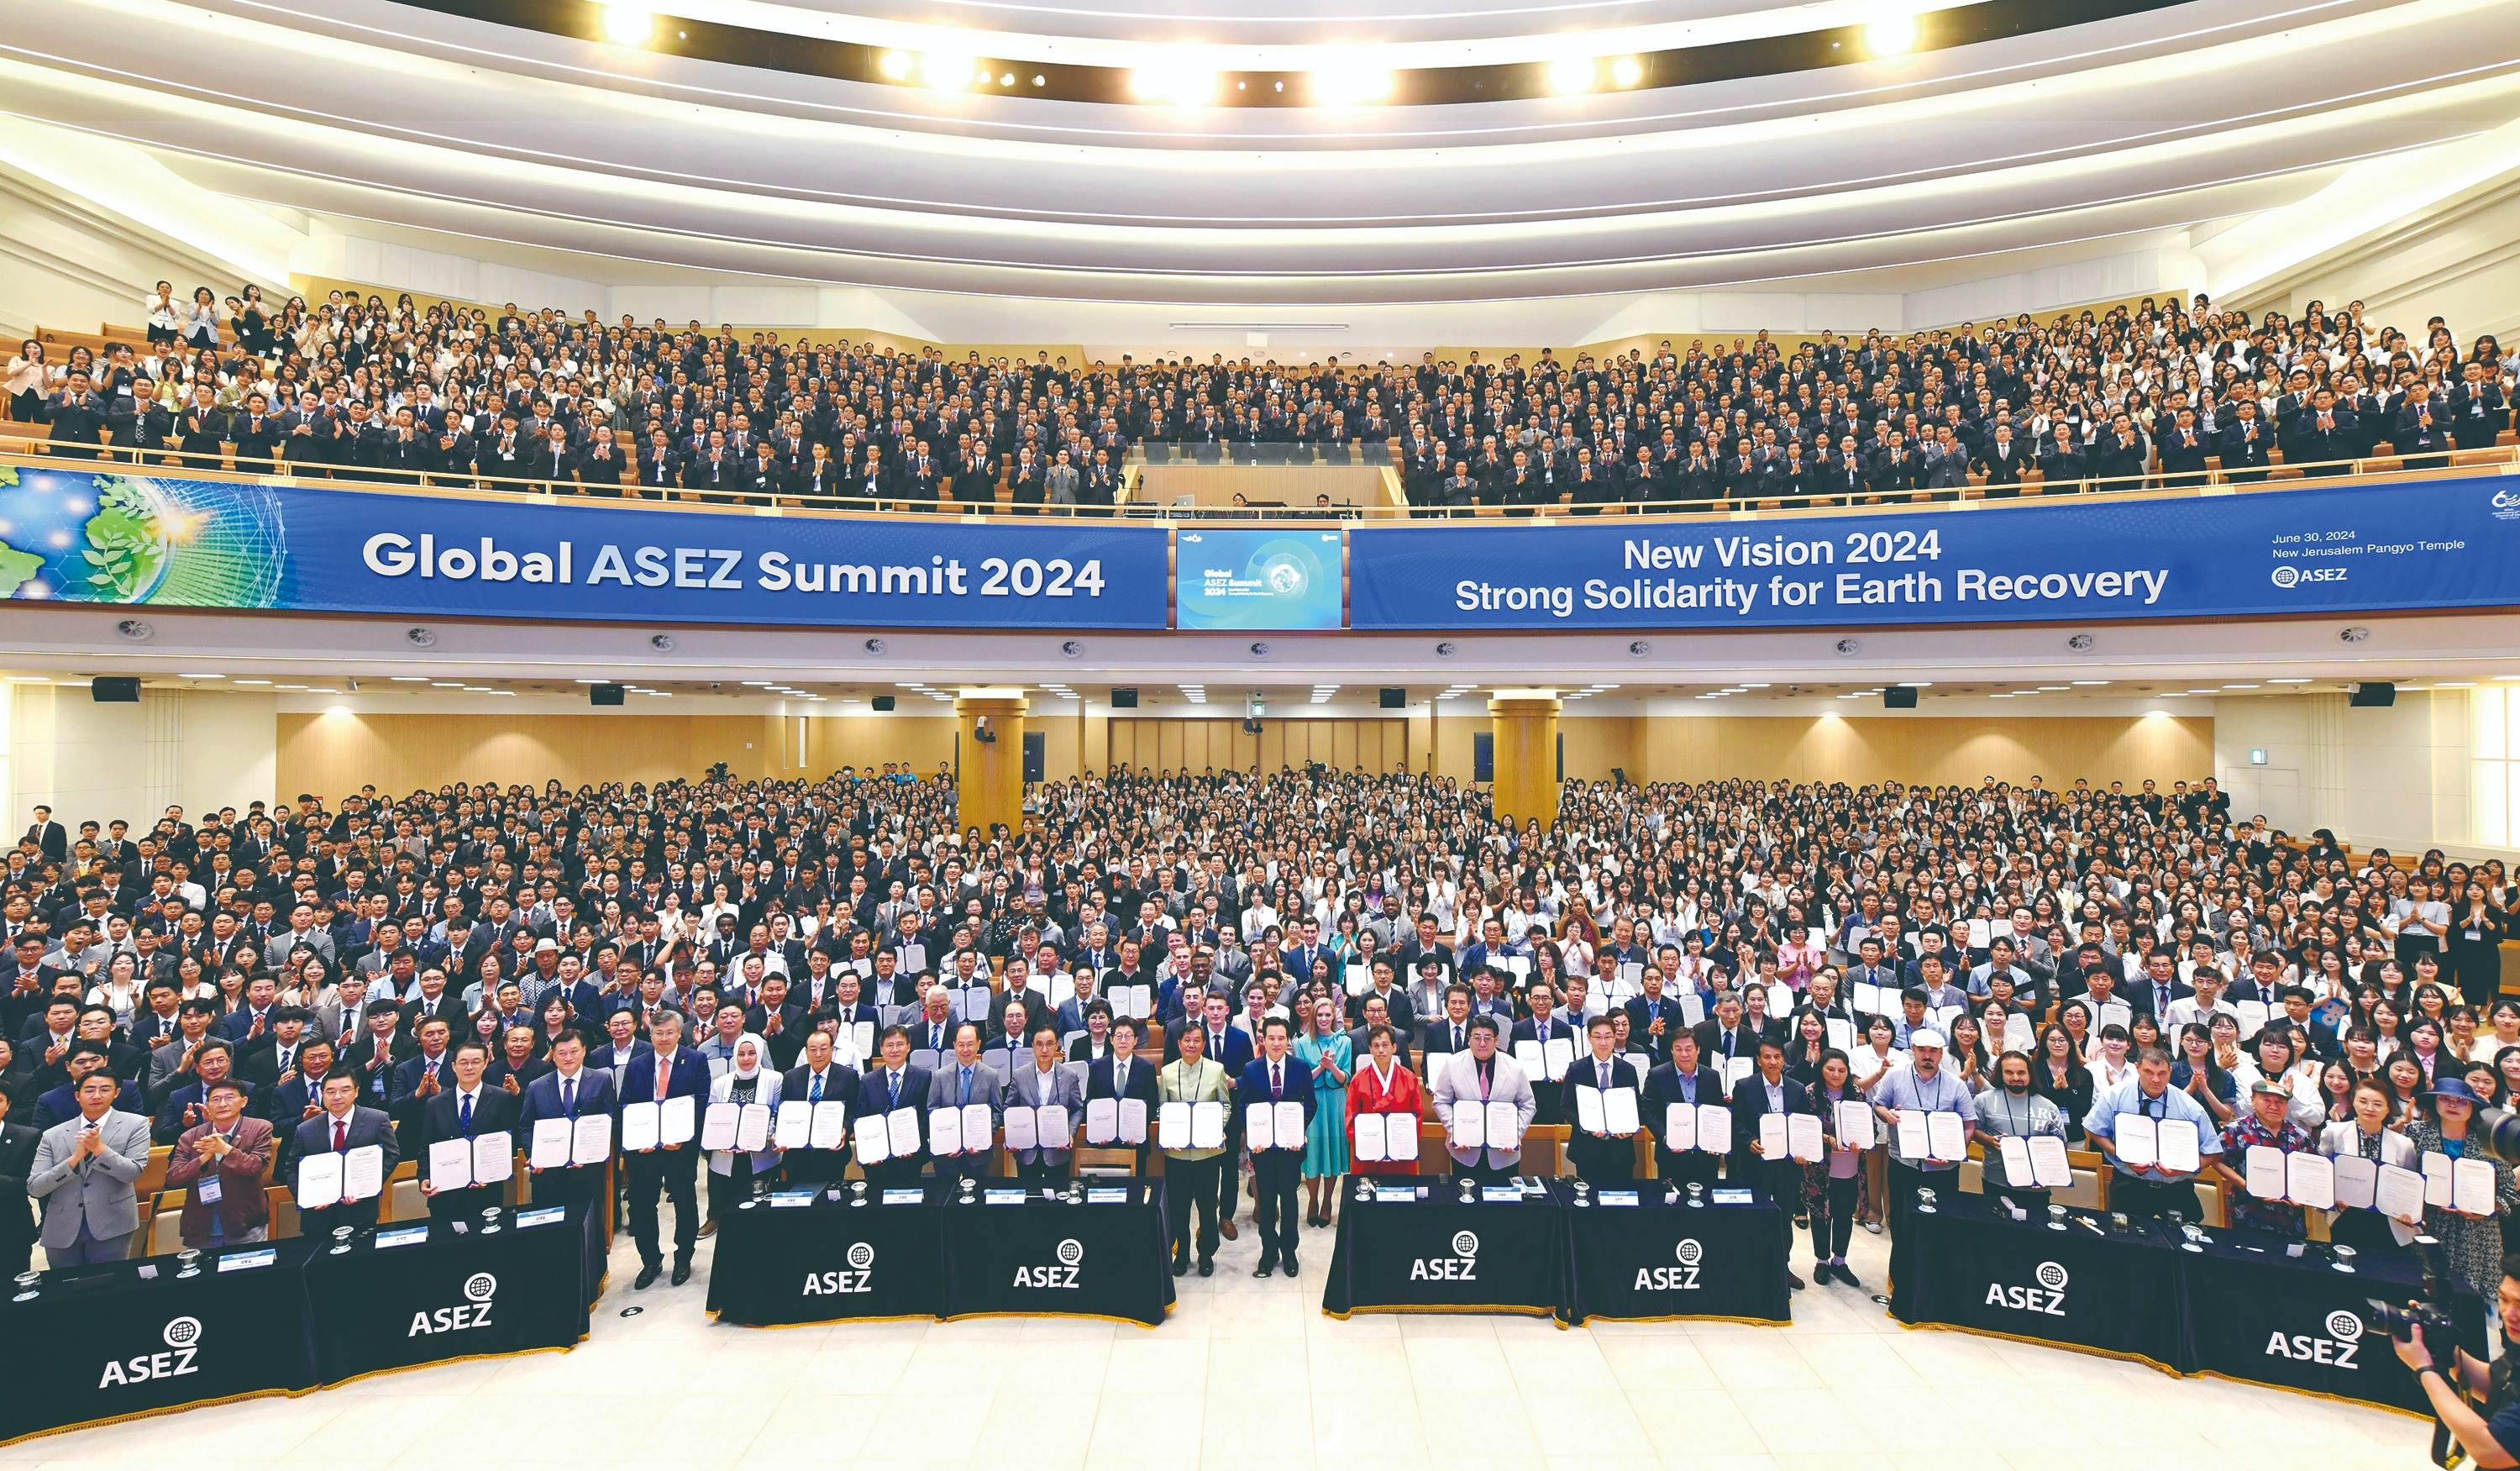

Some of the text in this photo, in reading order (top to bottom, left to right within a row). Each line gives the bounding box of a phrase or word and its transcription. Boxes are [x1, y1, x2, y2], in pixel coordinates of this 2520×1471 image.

[2271, 530, 2356, 544] June 30, 2024
[1625, 528, 1942, 570] New Vision 2024
[2272, 539, 2465, 559] New Jerusalem Pangyo Temple
[362, 533, 1105, 596] Global ASEZ Summit 2024
[1204, 569, 1232, 578] Global
[2300, 568, 2348, 582] ASEZ
[1204, 579, 1263, 587] ASEZ Summit
[1204, 587, 1226, 596] 2024
[1456, 569, 2170, 617] Strong Solidarity for Earth Recovery
[1013, 1266, 1079, 1289] ASEZ
[1410, 1258, 1476, 1280] ASEZ
[1634, 1267, 1700, 1290] ASEZ
[802, 1269, 872, 1295] ASEZ
[1985, 1283, 2066, 1316] ASEZ
[407, 1301, 492, 1337] ASEZ
[2265, 1331, 2359, 1369] ASEZ
[98, 1347, 198, 1389] ASEZ
